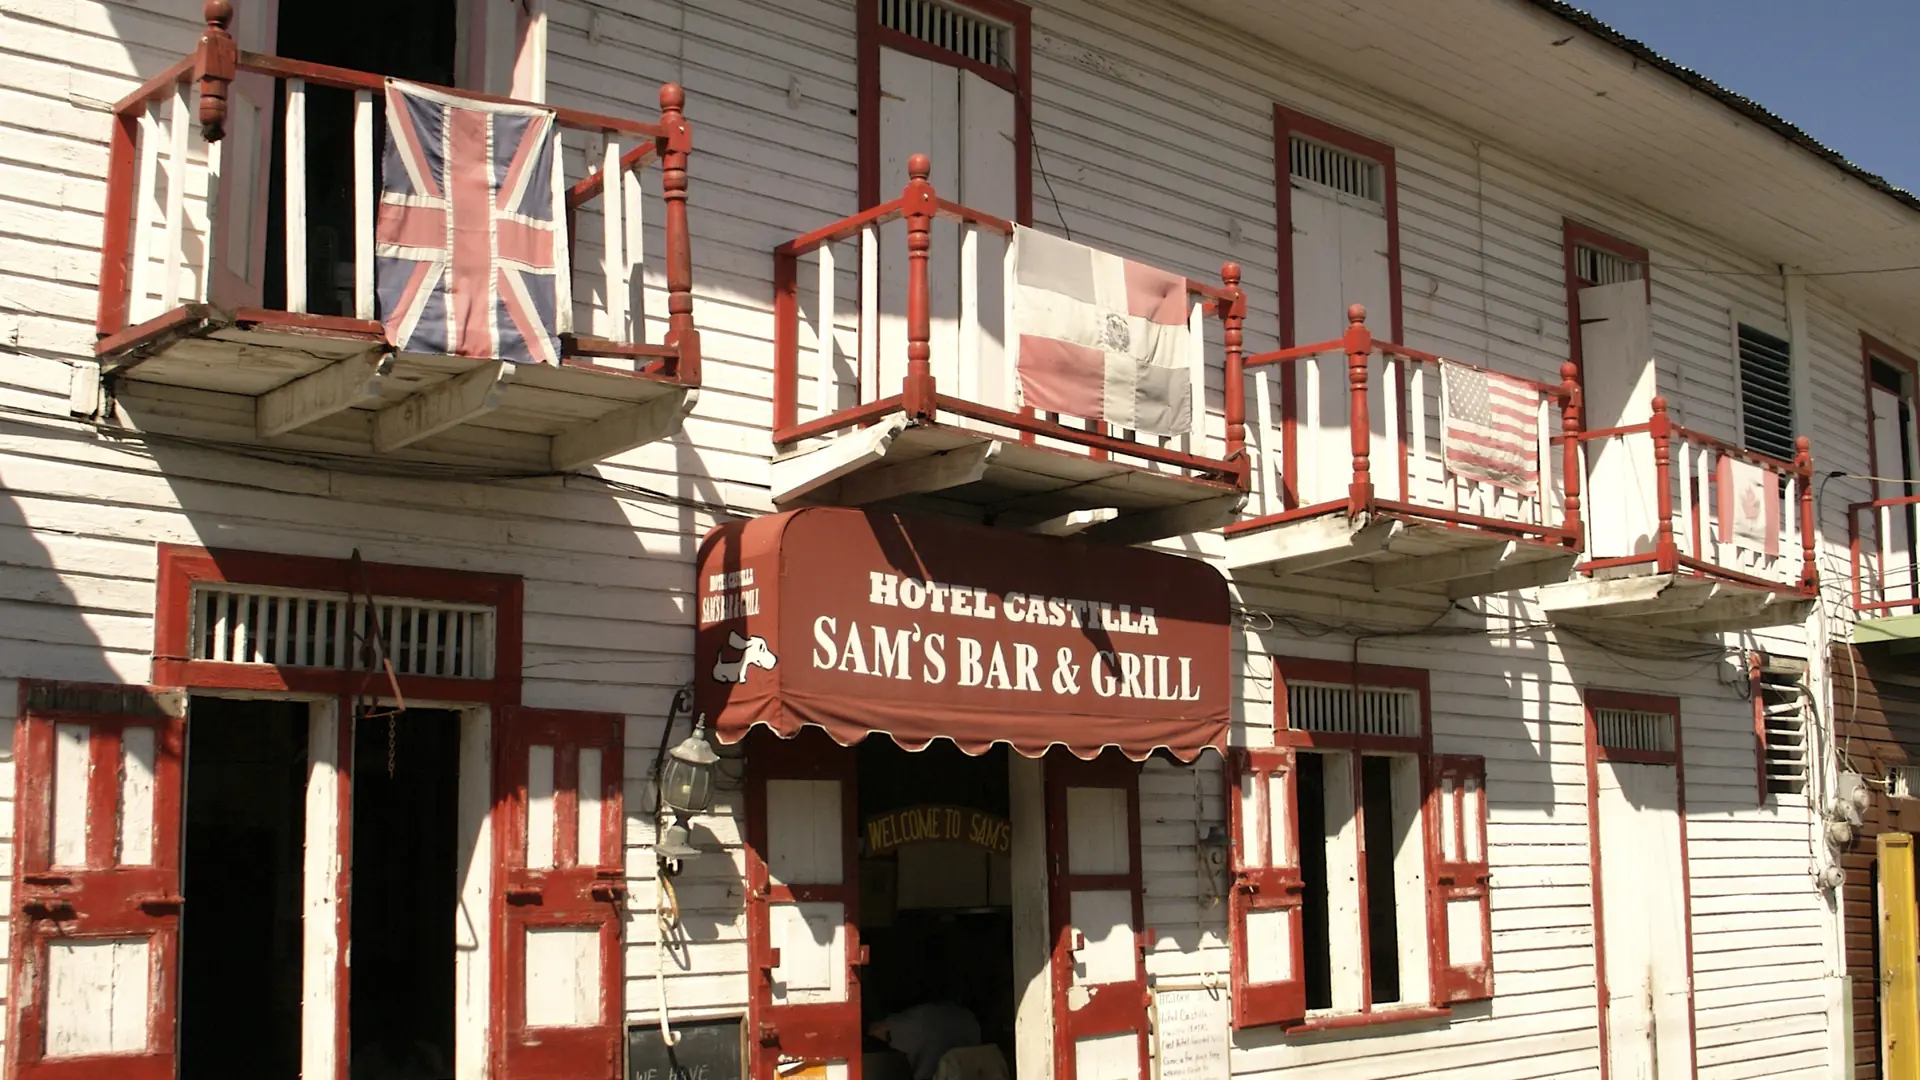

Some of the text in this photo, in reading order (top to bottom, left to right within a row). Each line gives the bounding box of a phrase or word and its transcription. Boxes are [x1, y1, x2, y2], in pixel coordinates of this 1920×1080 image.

[868, 571, 1158, 636] HOTEL CASTILLA
[813, 615, 1201, 701] SAM'S BAR & GRILL
[867, 807, 940, 850] WELCOME
[944, 808, 961, 838] TO
